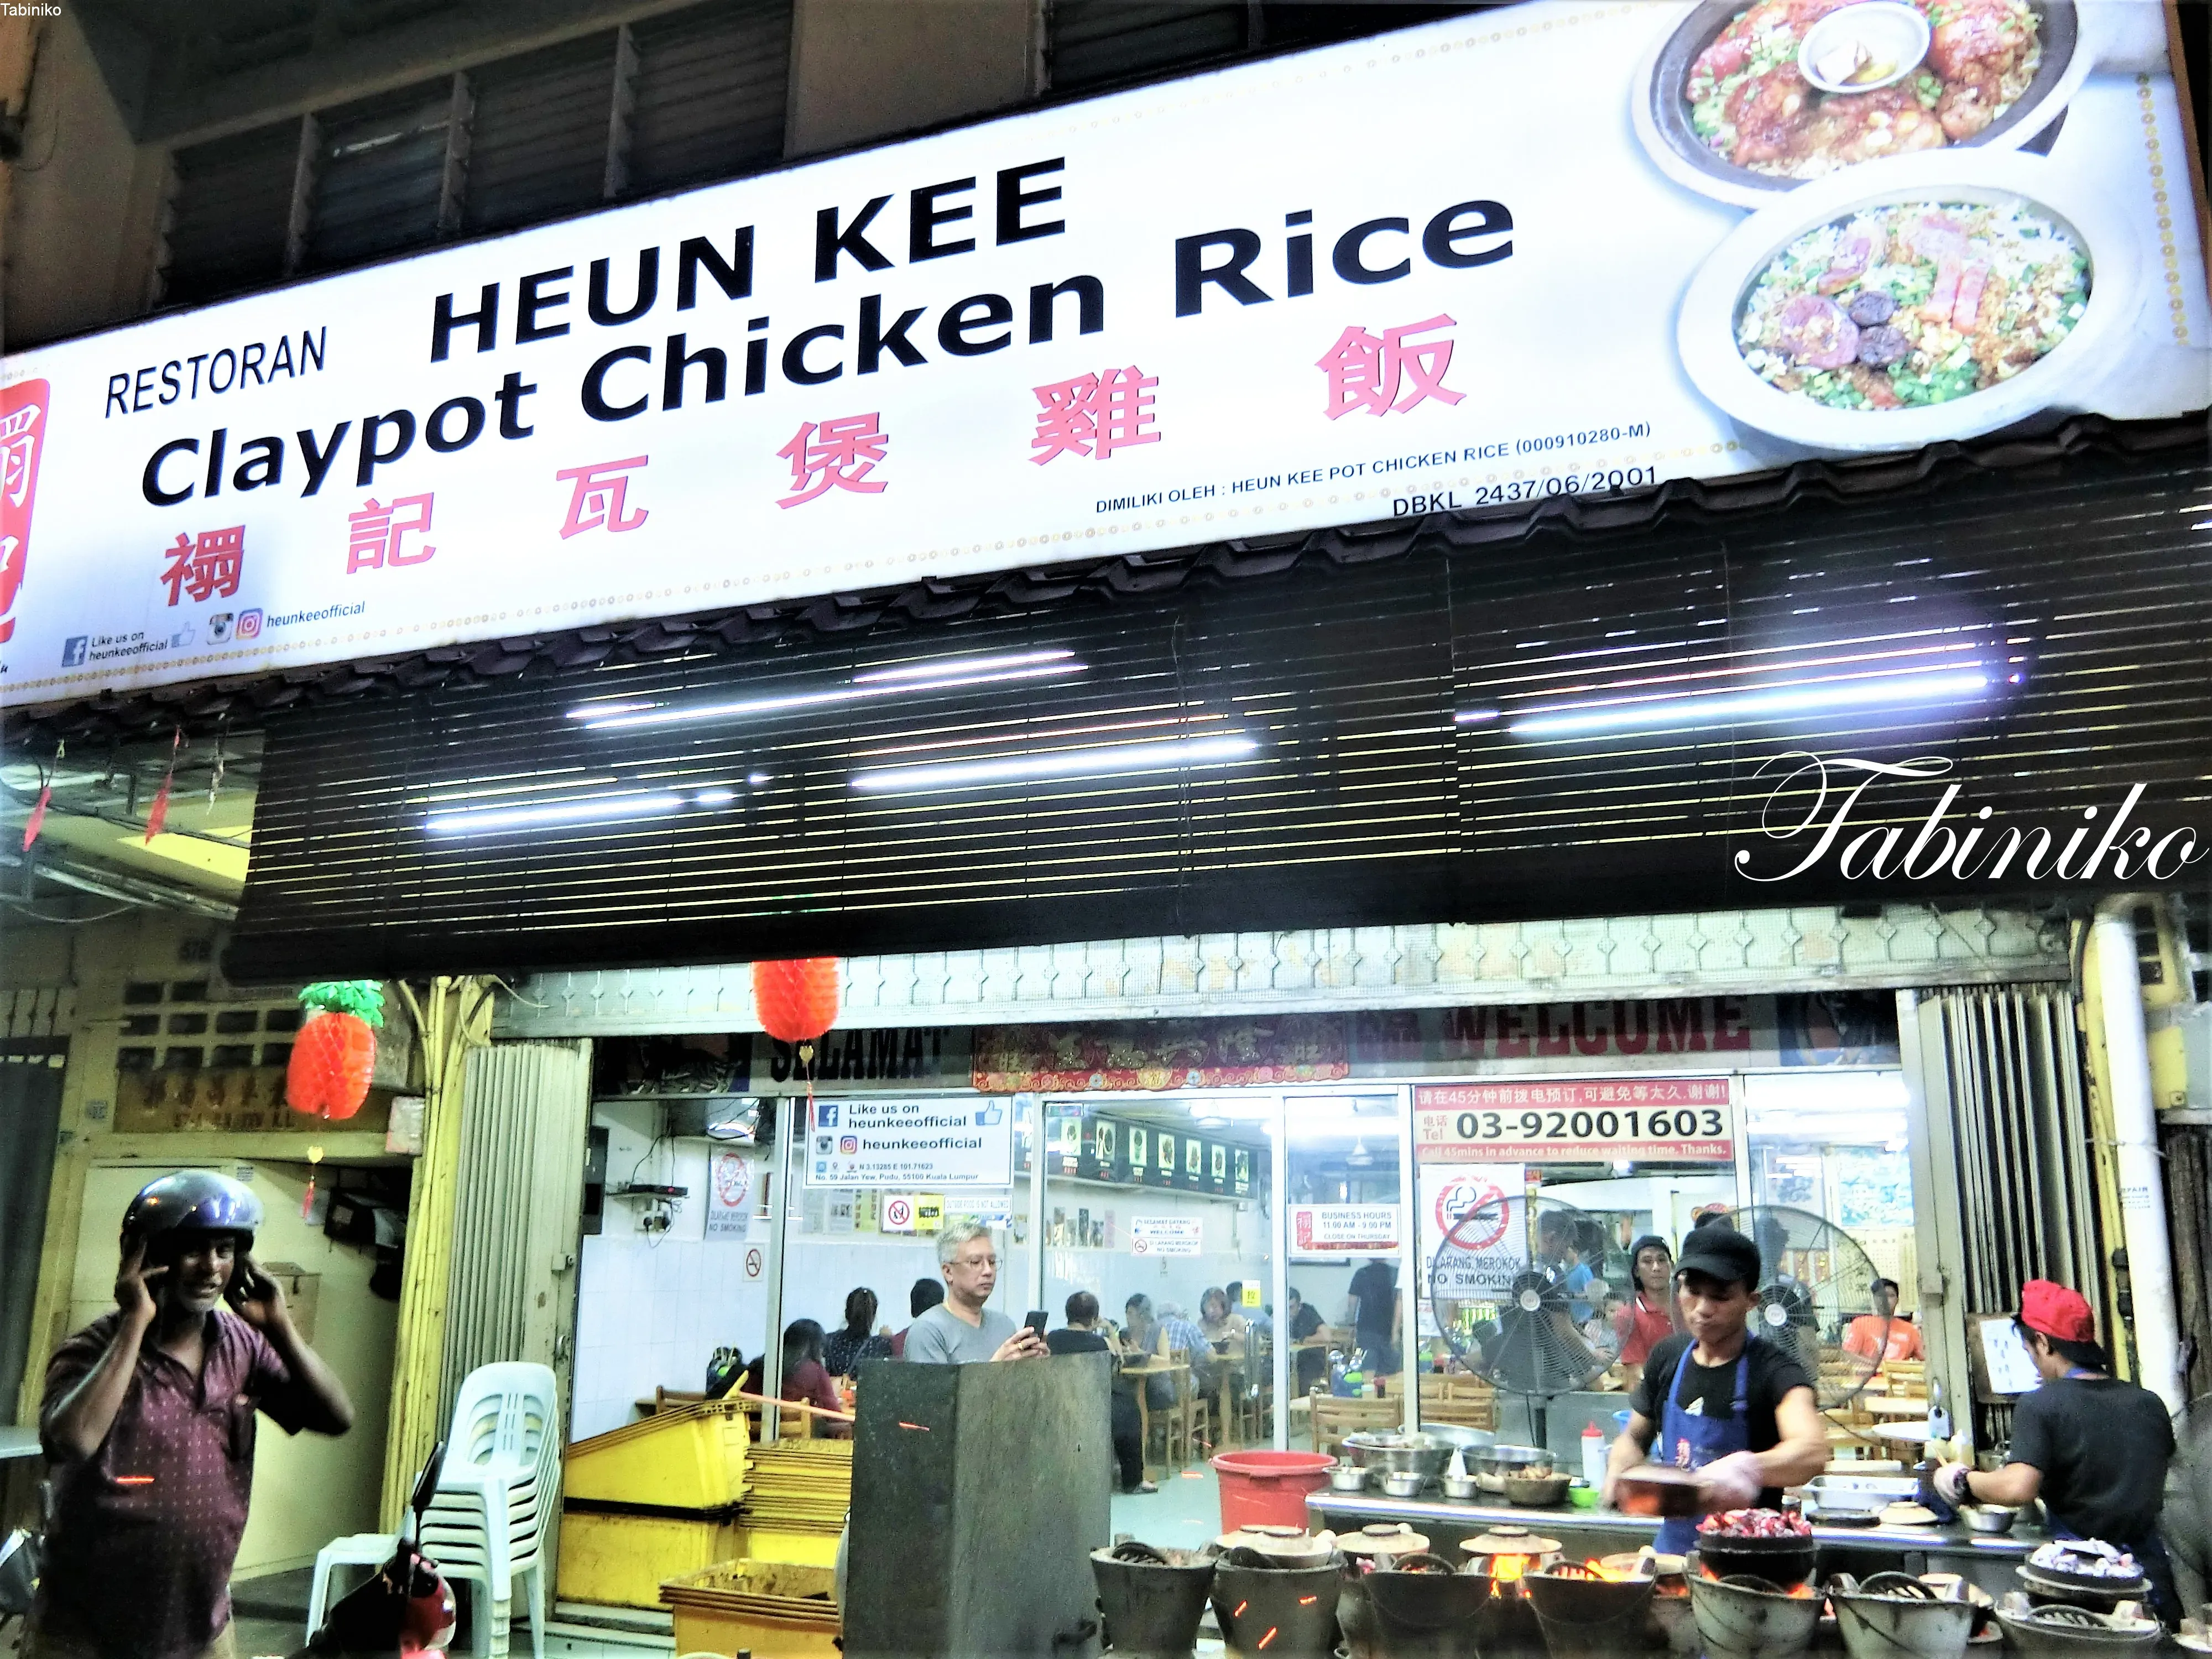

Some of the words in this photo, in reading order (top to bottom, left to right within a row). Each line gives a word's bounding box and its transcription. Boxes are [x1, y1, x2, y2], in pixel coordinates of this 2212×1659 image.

[431, 225, 754, 363] HEUN
[815, 156, 1066, 283] KEE
[143, 372, 538, 507] Claypot
[581, 274, 1104, 422] Chicken
[1175, 200, 1514, 318] Rice
[105, 326, 327, 419] RESTORAN
[1096, 492, 1162, 513] DIMILIKI
[1169, 484, 1215, 502] OLEH
[1233, 476, 1280, 494] HEUN
[1288, 469, 1323, 486] KEE
[1329, 463, 1366, 480] POT
[1373, 450, 1456, 473] CHICKEN
[1464, 442, 1509, 461] RICE
[1516, 421, 1651, 456] (000910280-M)
[1393, 491, 1462, 517] DBKL
[1475, 466, 1656, 505] 2437/06/2001
[267, 601, 365, 628] heunkeeofficial
[92, 636, 112, 648] Like
[116, 633, 127, 644] us
[131, 631, 144, 641] on
[89, 639, 168, 661] heunkeeofficial
[1442, 995, 1751, 1061] WELCOME
[849, 1104, 877, 1114] Like
[902, 1105, 919, 1114] on
[849, 1115, 966, 1129] heunkeeofficial
[1423, 1114, 1448, 1127] 电话
[1457, 1109, 1723, 1139] 03-92001603
[1423, 1128, 1443, 1140] Tel
[863, 1137, 982, 1150] heunkeeofficial
[1485, 1146, 1496, 1156] in
[1499, 1146, 1543, 1157] advance
[1547, 1146, 1558, 1156] to
[1561, 1145, 1598, 1156] reduce
[1601, 1144, 1646, 1157] waiting
[1648, 1145, 1678, 1155] time.
[1681, 1143, 1726, 1155] Thanks.
[949, 1172, 979, 1182] Lumpur
[1322, 1212, 1361, 1220] BUSINESS
[1364, 1212, 1392, 1220] HOURS
[1455, 1274, 1510, 1285] SMOKIN
